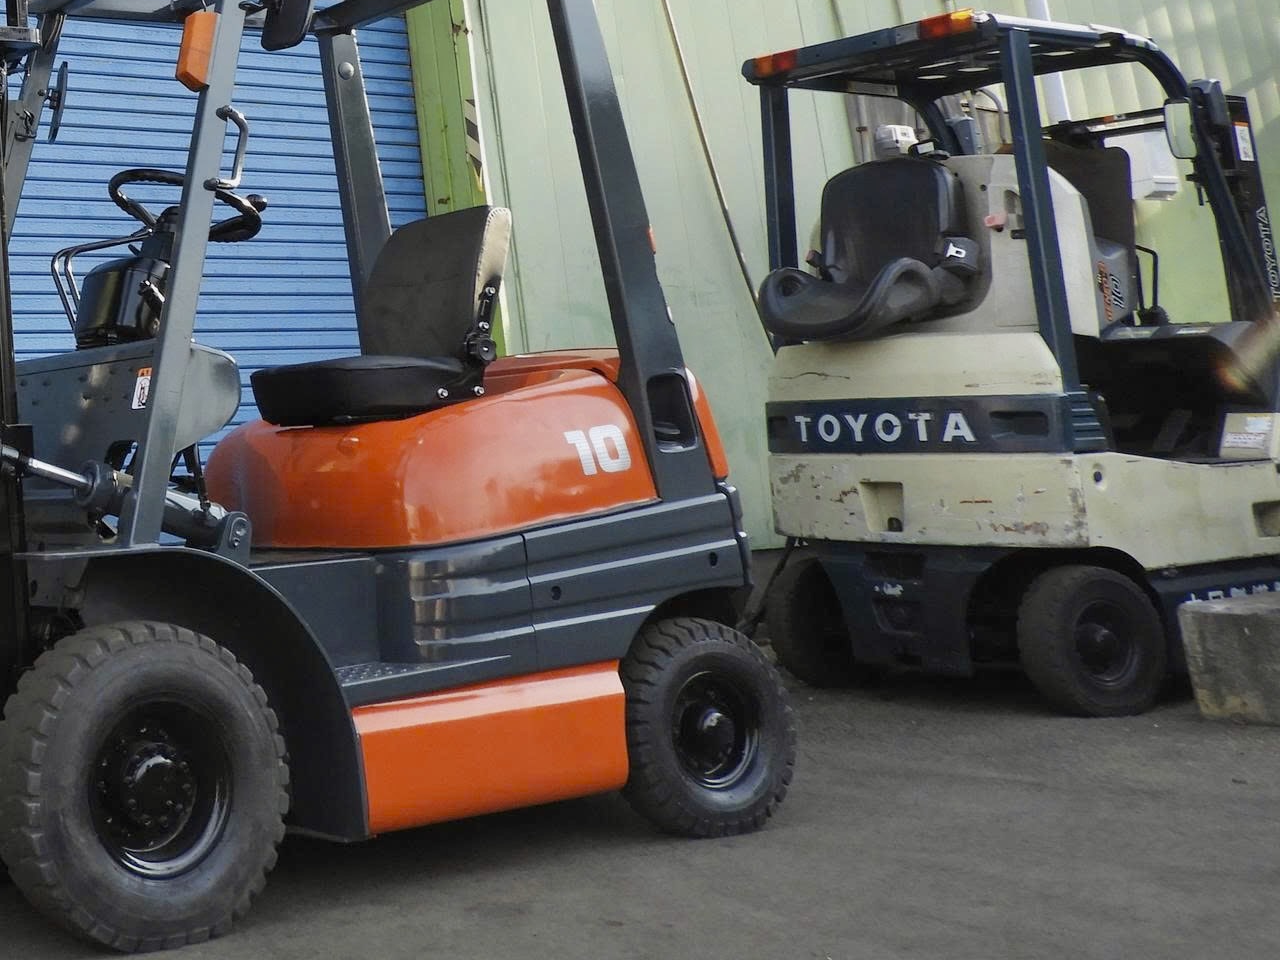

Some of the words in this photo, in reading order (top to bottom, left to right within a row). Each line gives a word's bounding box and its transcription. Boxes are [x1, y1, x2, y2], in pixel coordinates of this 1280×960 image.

[1256, 206, 1280, 303] TOYOTA
[564, 424, 631, 476] 10
[794, 412, 976, 443] TOYOTA
